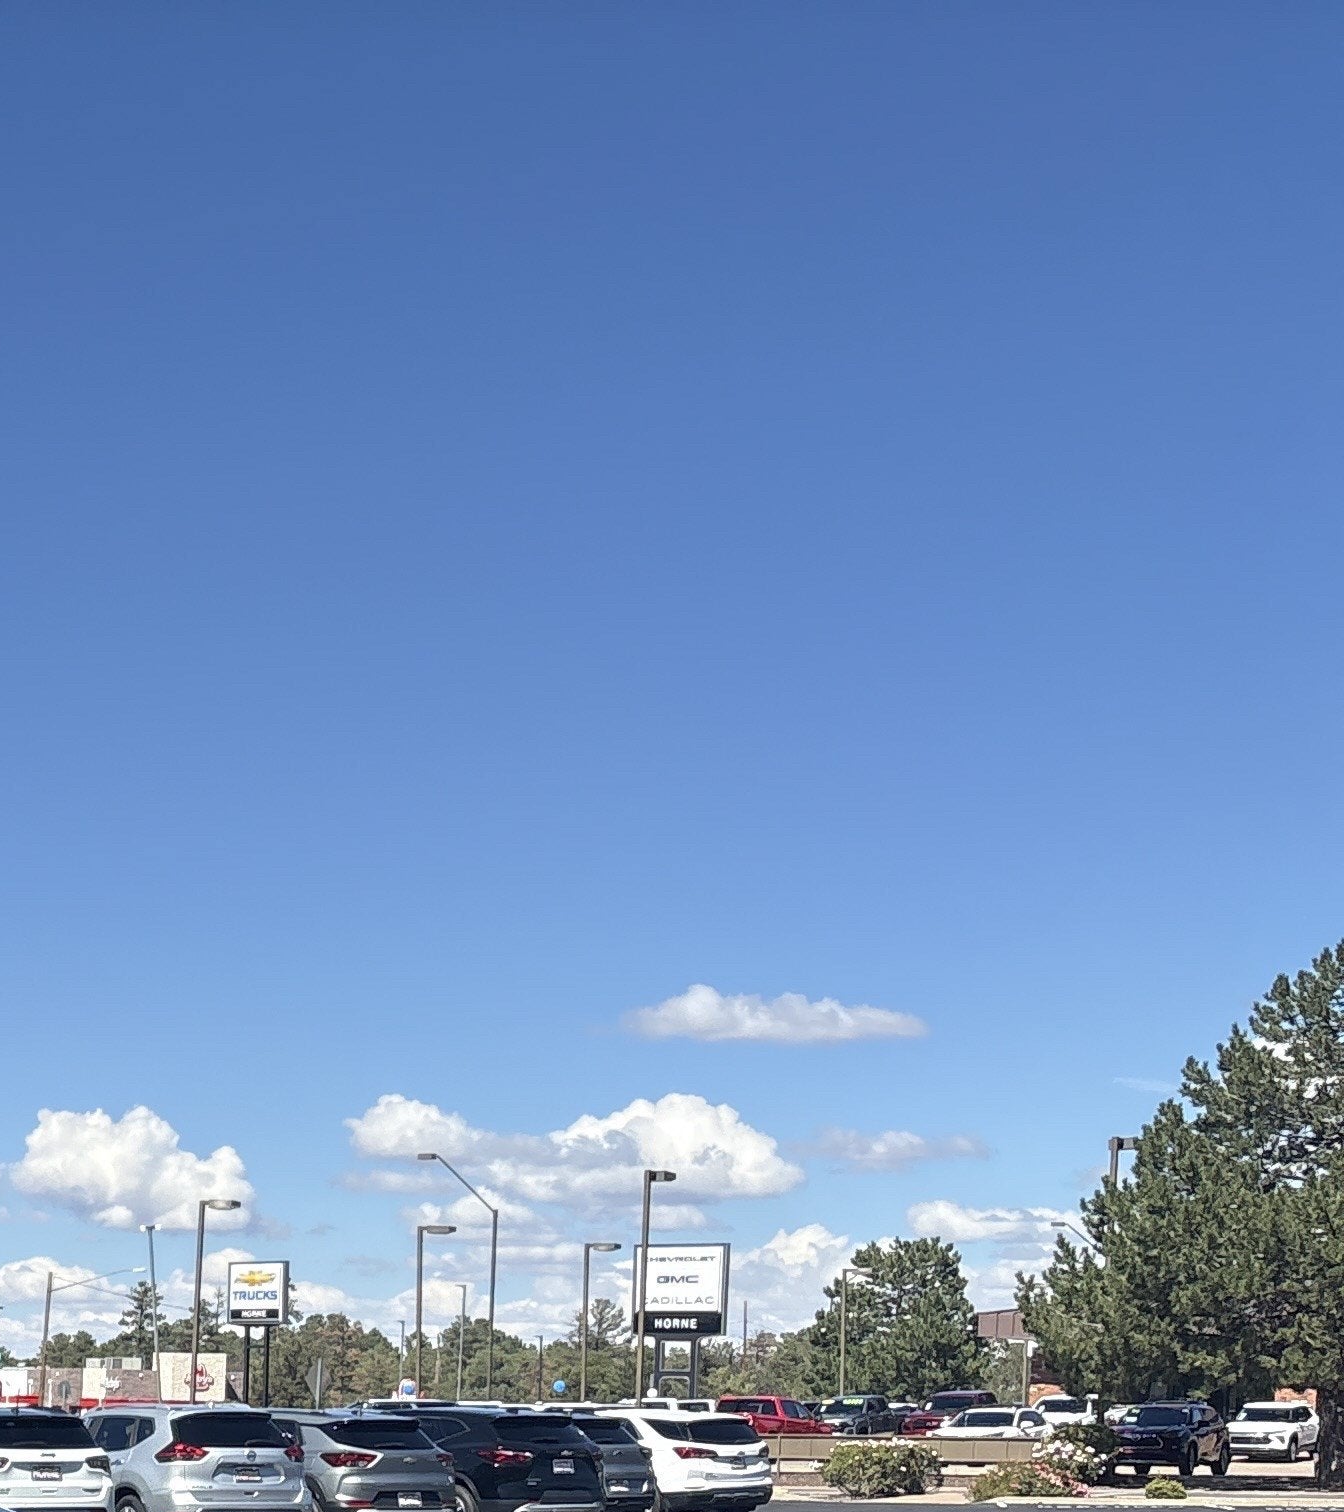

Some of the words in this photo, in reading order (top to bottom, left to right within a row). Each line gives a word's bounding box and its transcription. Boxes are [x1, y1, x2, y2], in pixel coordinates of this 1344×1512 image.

[646, 1255, 716, 1263] HEVROLET
[656, 1275, 699, 1284] GMC
[233, 1290, 278, 1300] TRUCKS
[654, 1317, 698, 1329] HORNE
